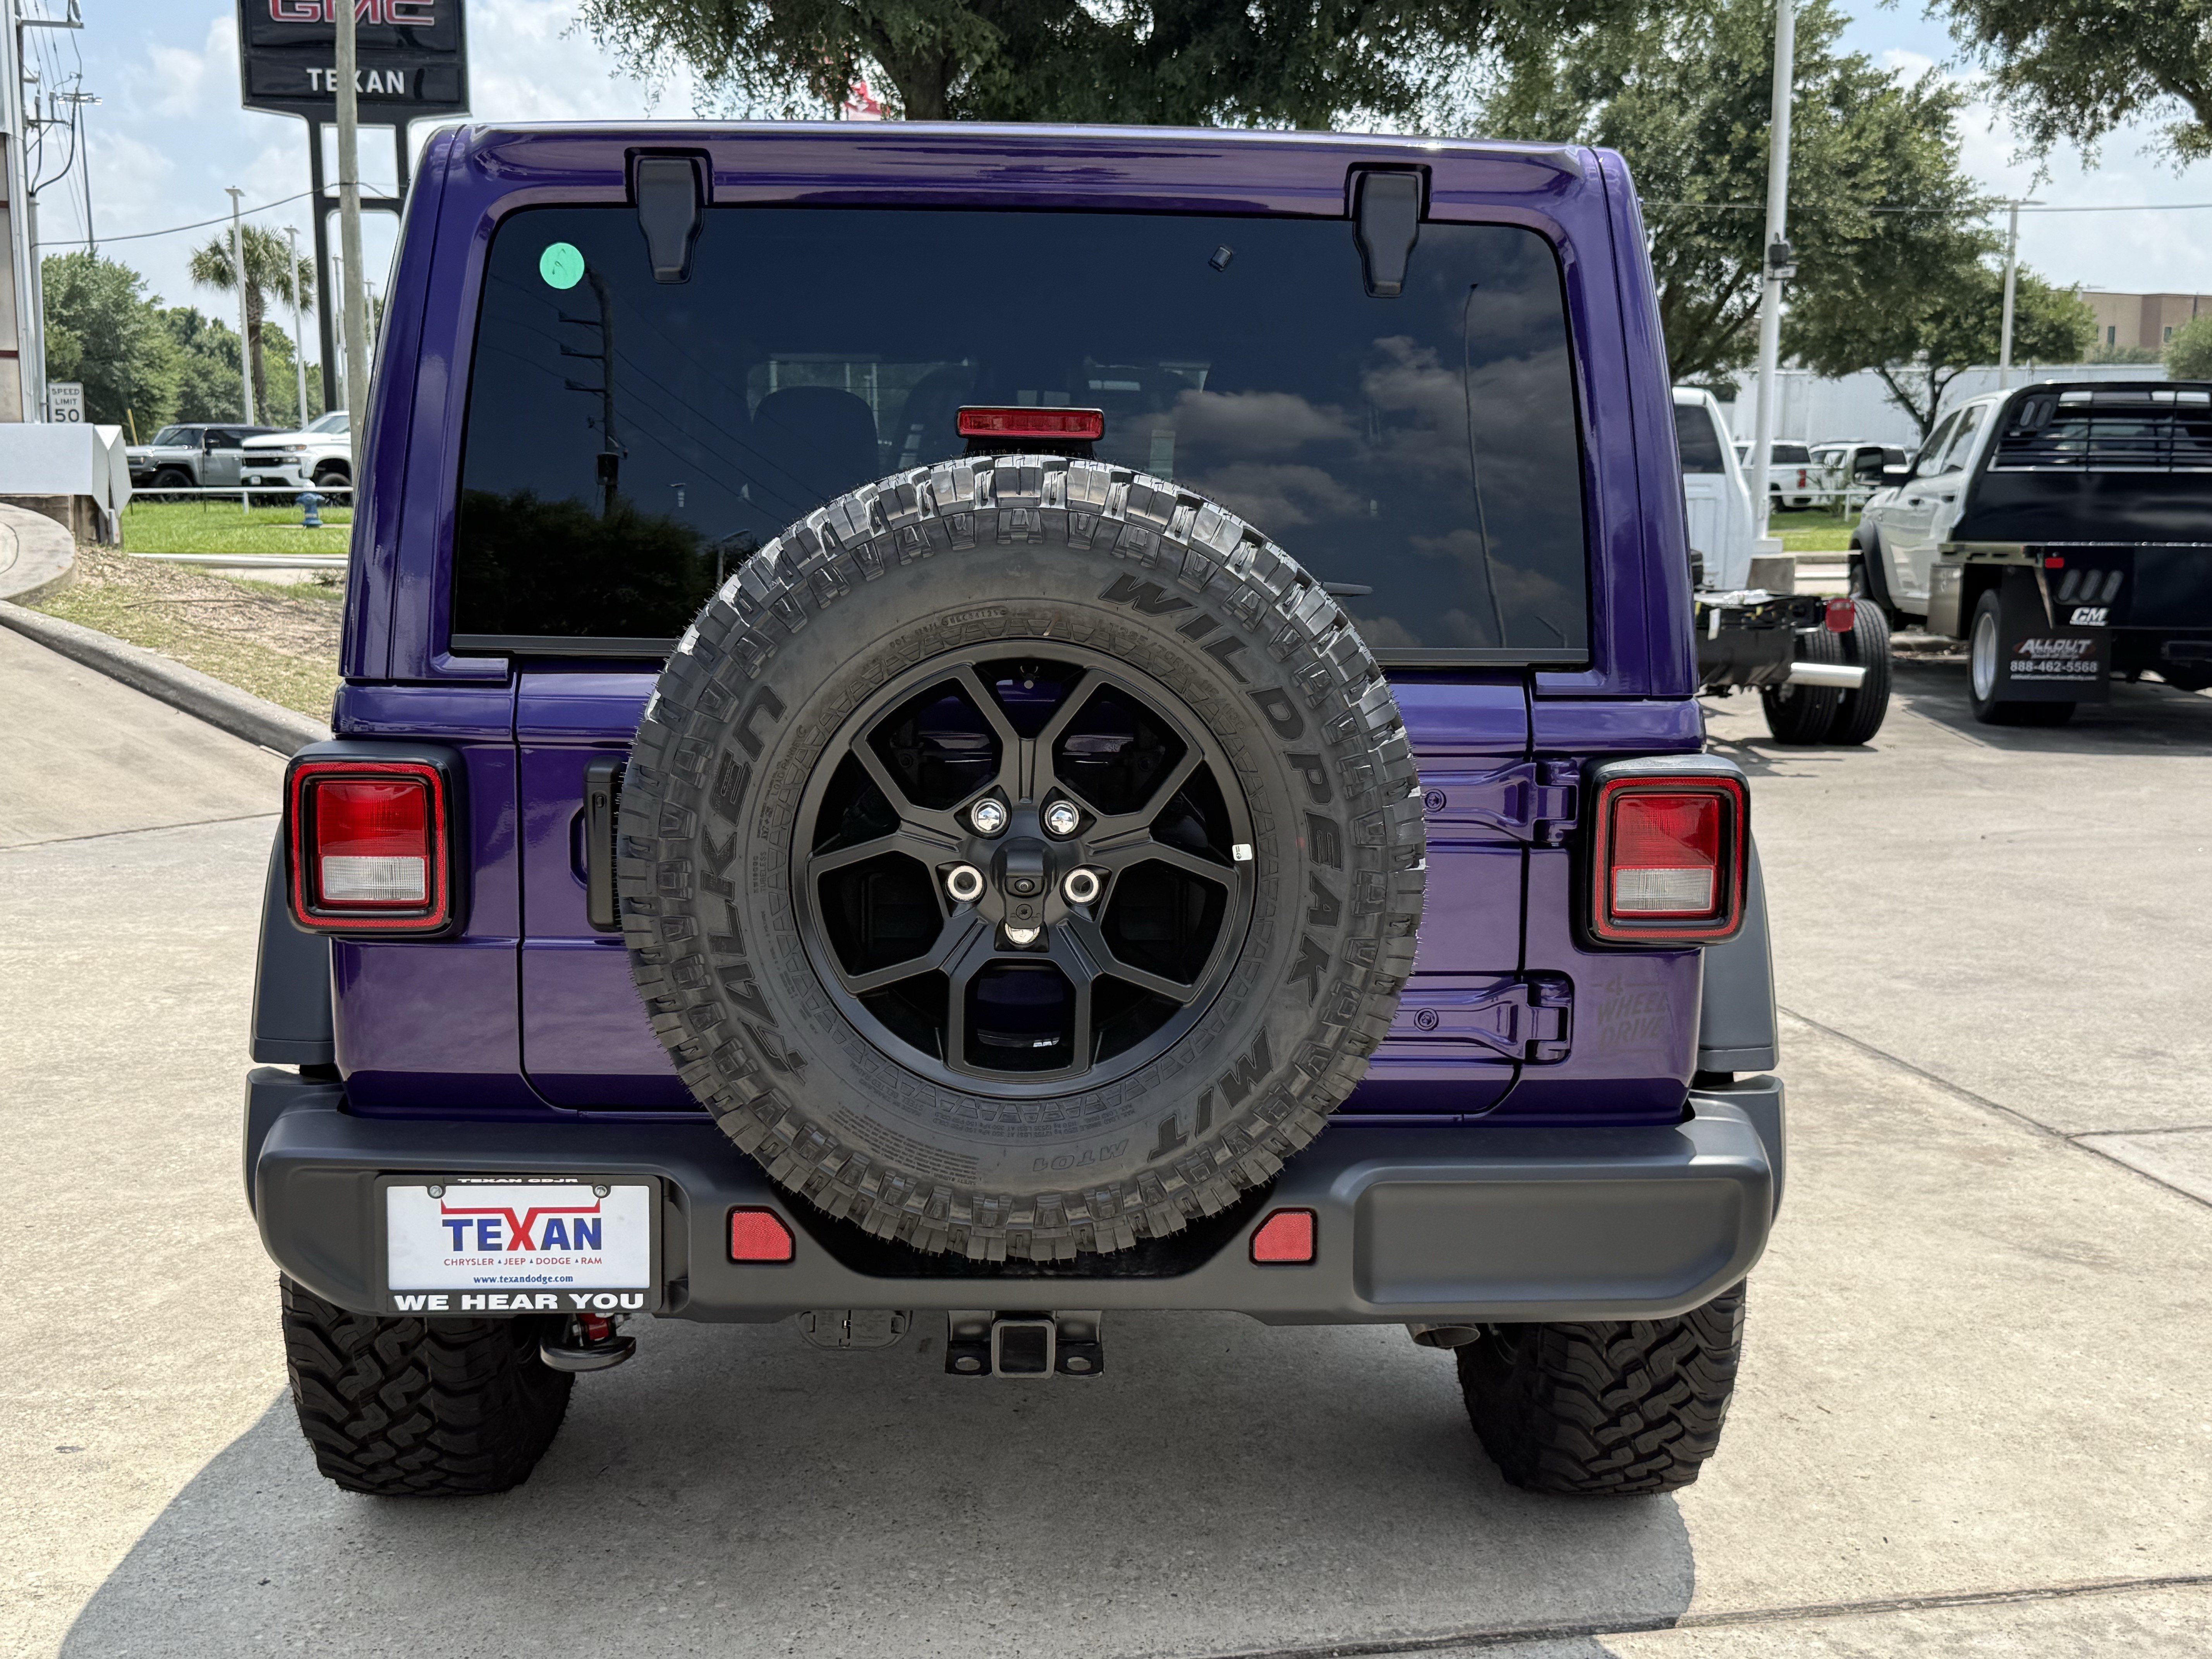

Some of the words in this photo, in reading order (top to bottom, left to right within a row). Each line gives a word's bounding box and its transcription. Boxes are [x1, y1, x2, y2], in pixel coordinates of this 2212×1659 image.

[55, 409, 79, 422] 50
[2018, 639, 2091, 654] ALLOUT
[2010, 660, 2097, 673] 888-462-5568
[769, 771, 785, 796] LOAD
[442, 1207, 602, 1251] TEXAN
[473, 1274, 573, 1284] www.texandodge.com
[394, 1295, 449, 1311] WE
[461, 1294, 558, 1310] HEAR
[568, 1293, 644, 1309] YOU
